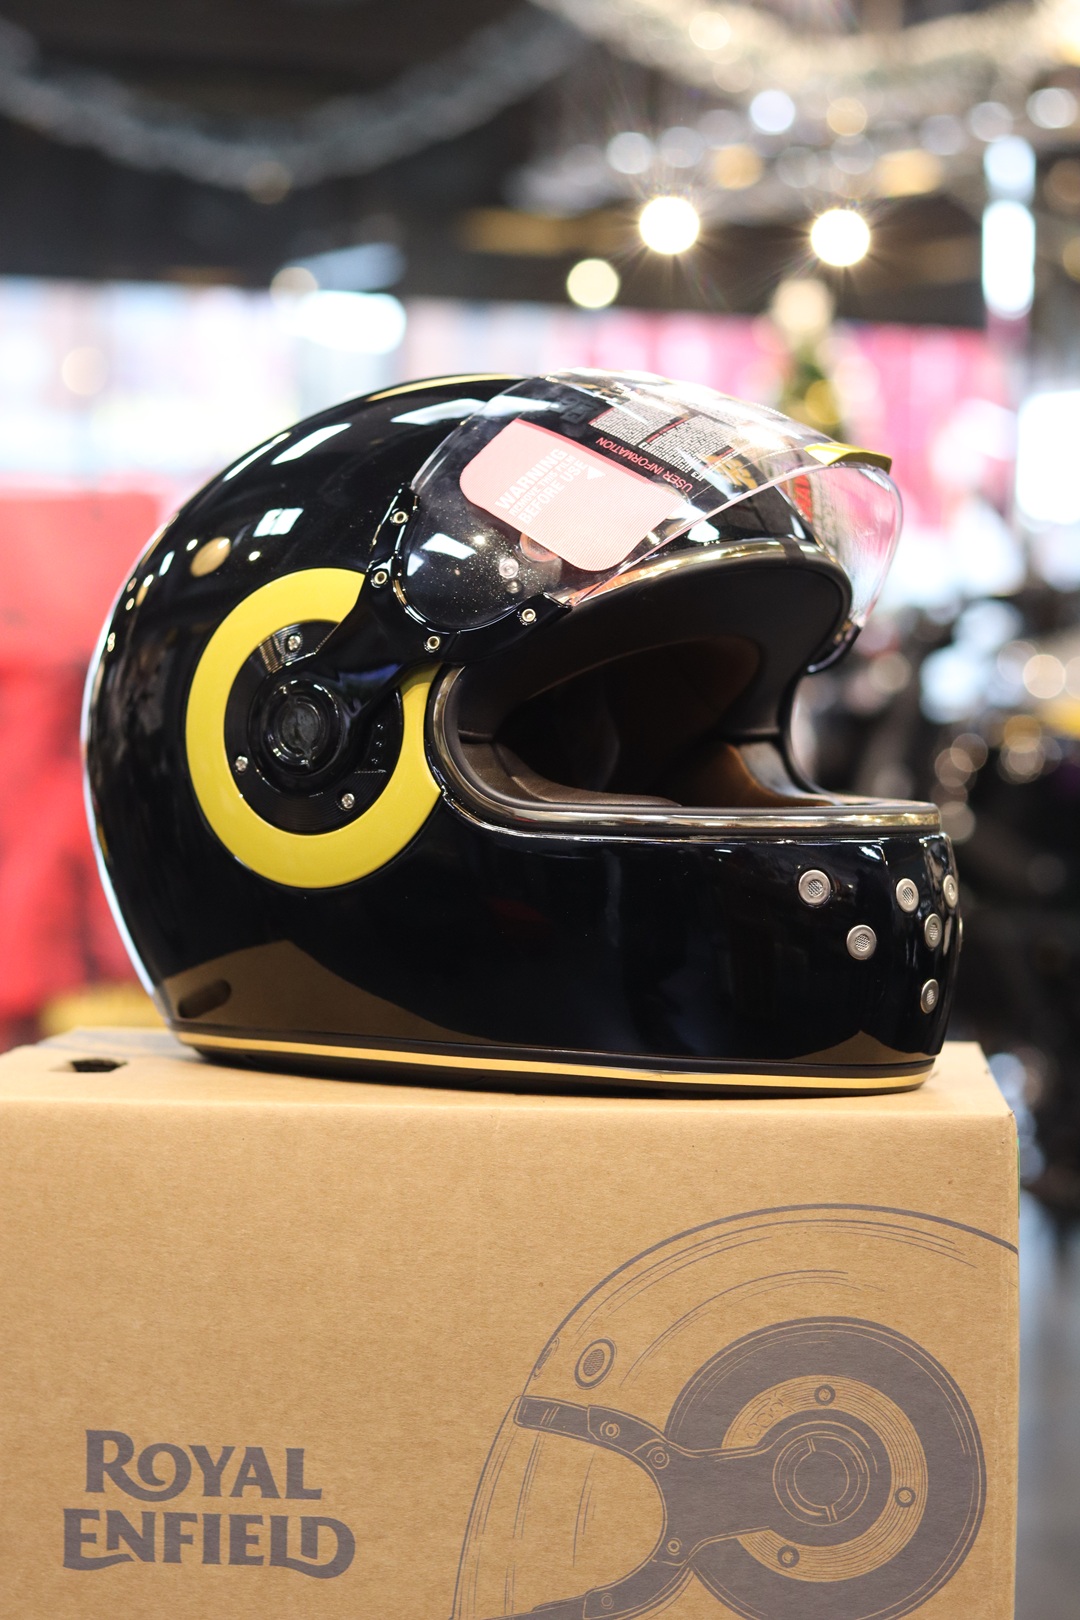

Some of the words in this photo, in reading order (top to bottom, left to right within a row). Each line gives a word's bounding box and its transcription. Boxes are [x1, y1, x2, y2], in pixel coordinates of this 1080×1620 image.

[494, 448, 568, 509] WARNING
[508, 485, 541, 516] REMOVE
[538, 470, 558, 486] THIS
[555, 454, 577, 472] FILM
[595, 436, 663, 475] INFORMATION
[663, 470, 693, 492] USER
[517, 479, 565, 525] BEFORE
[559, 459, 588, 482] USE
[85, 1429, 322, 1502] ROYAL
[63, 1509, 356, 1579] ENFIELD
